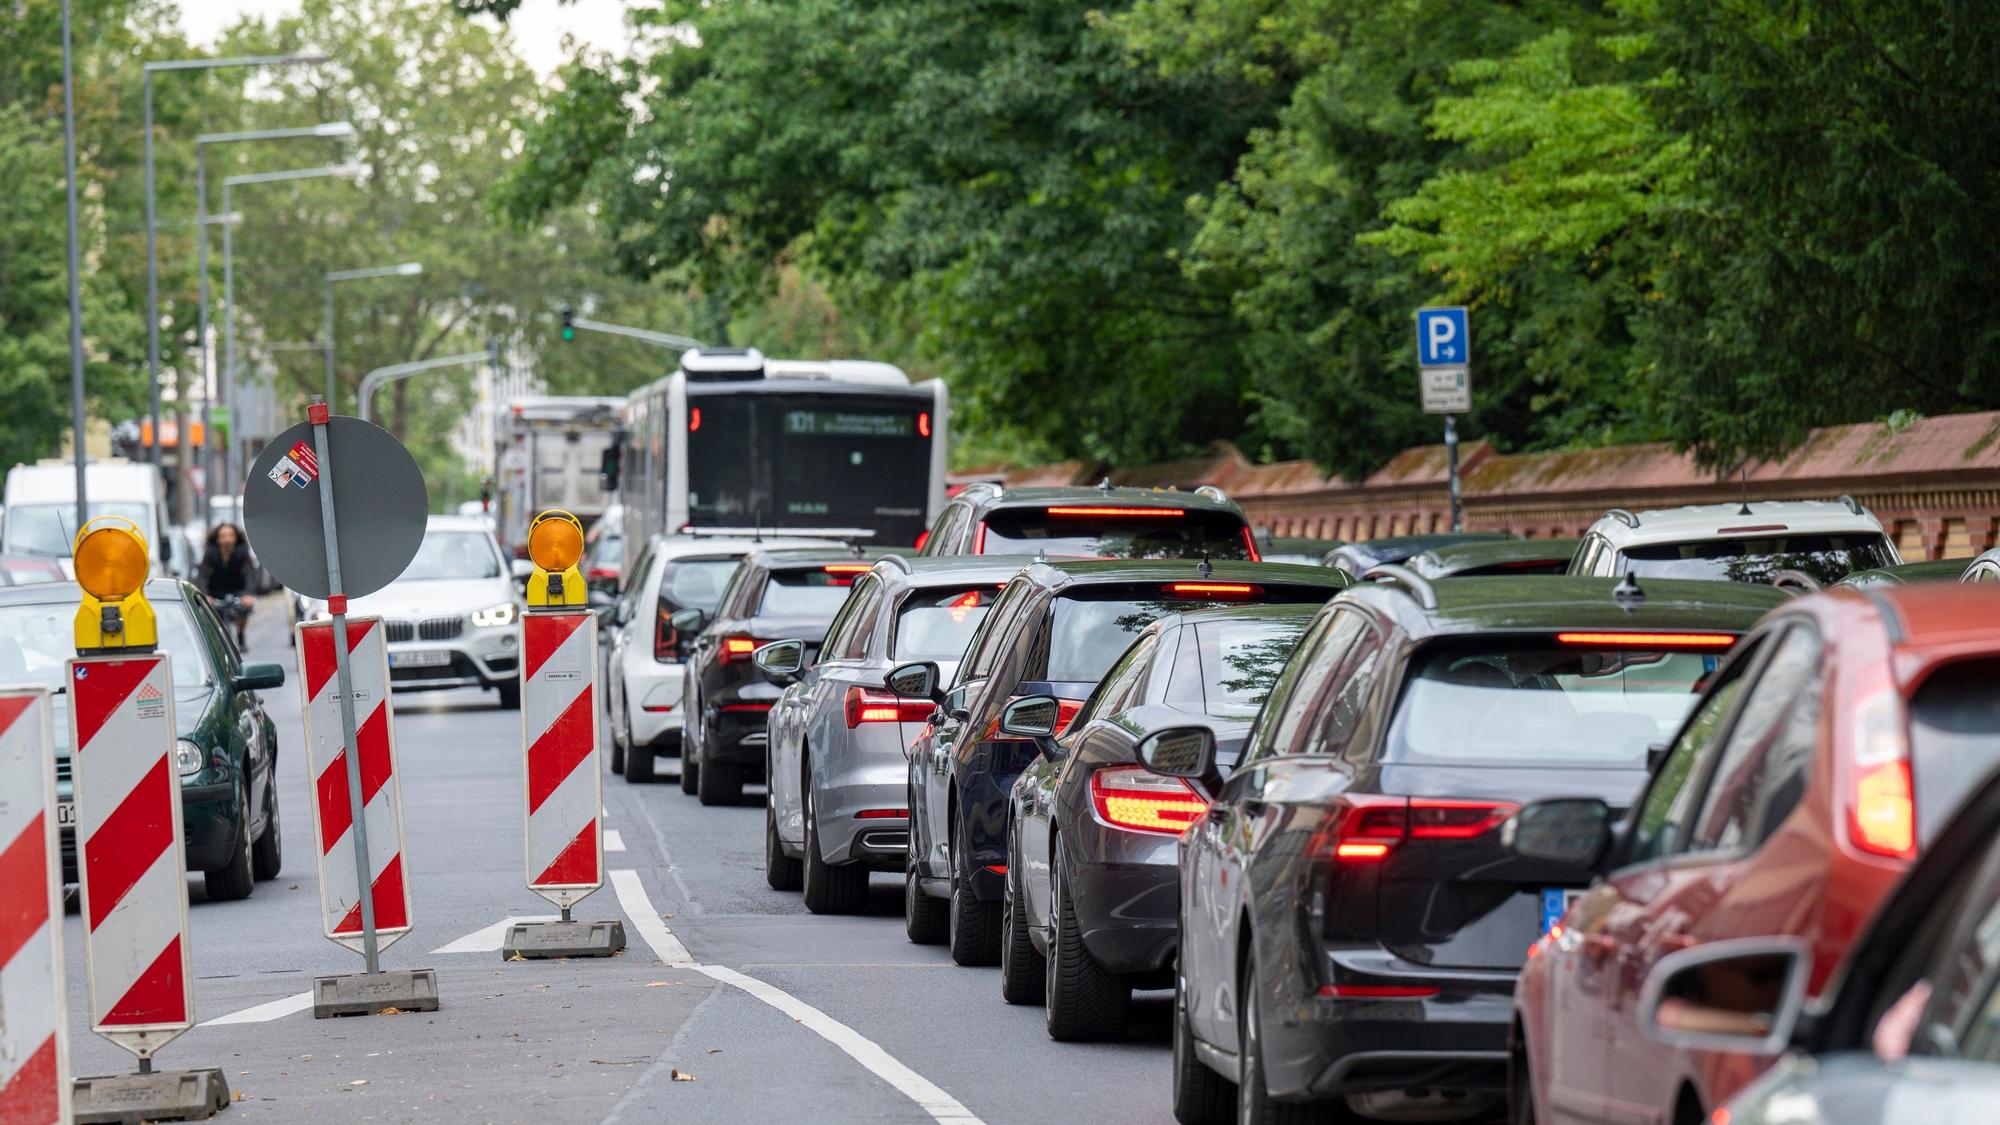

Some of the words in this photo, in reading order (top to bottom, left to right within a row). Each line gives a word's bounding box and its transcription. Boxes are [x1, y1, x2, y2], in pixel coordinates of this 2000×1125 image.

[1428, 316, 1455, 360] P
[788, 411, 815, 433] 101
[788, 502, 828, 514] MAN
